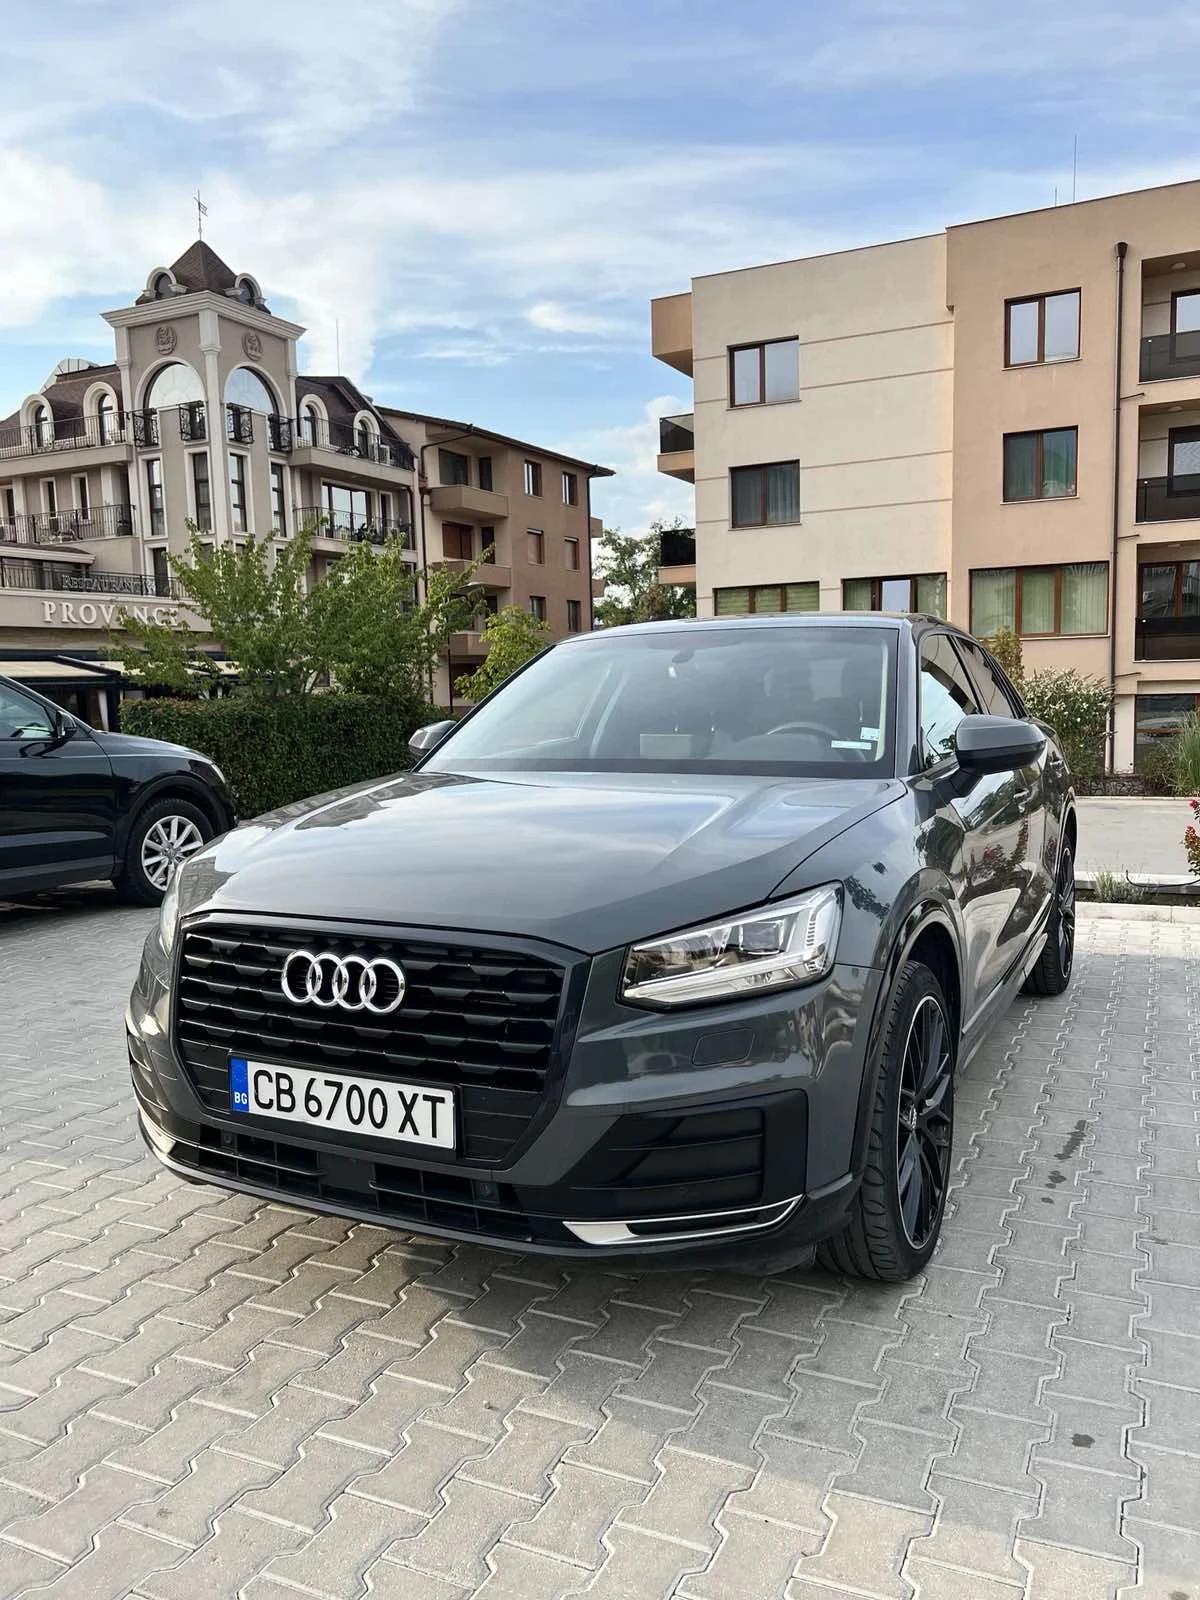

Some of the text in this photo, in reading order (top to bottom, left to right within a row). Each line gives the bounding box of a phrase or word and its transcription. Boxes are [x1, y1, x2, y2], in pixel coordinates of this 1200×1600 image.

[234, 1091, 248, 1105] BG
[253, 1069, 446, 1139] CB 6700 XT
